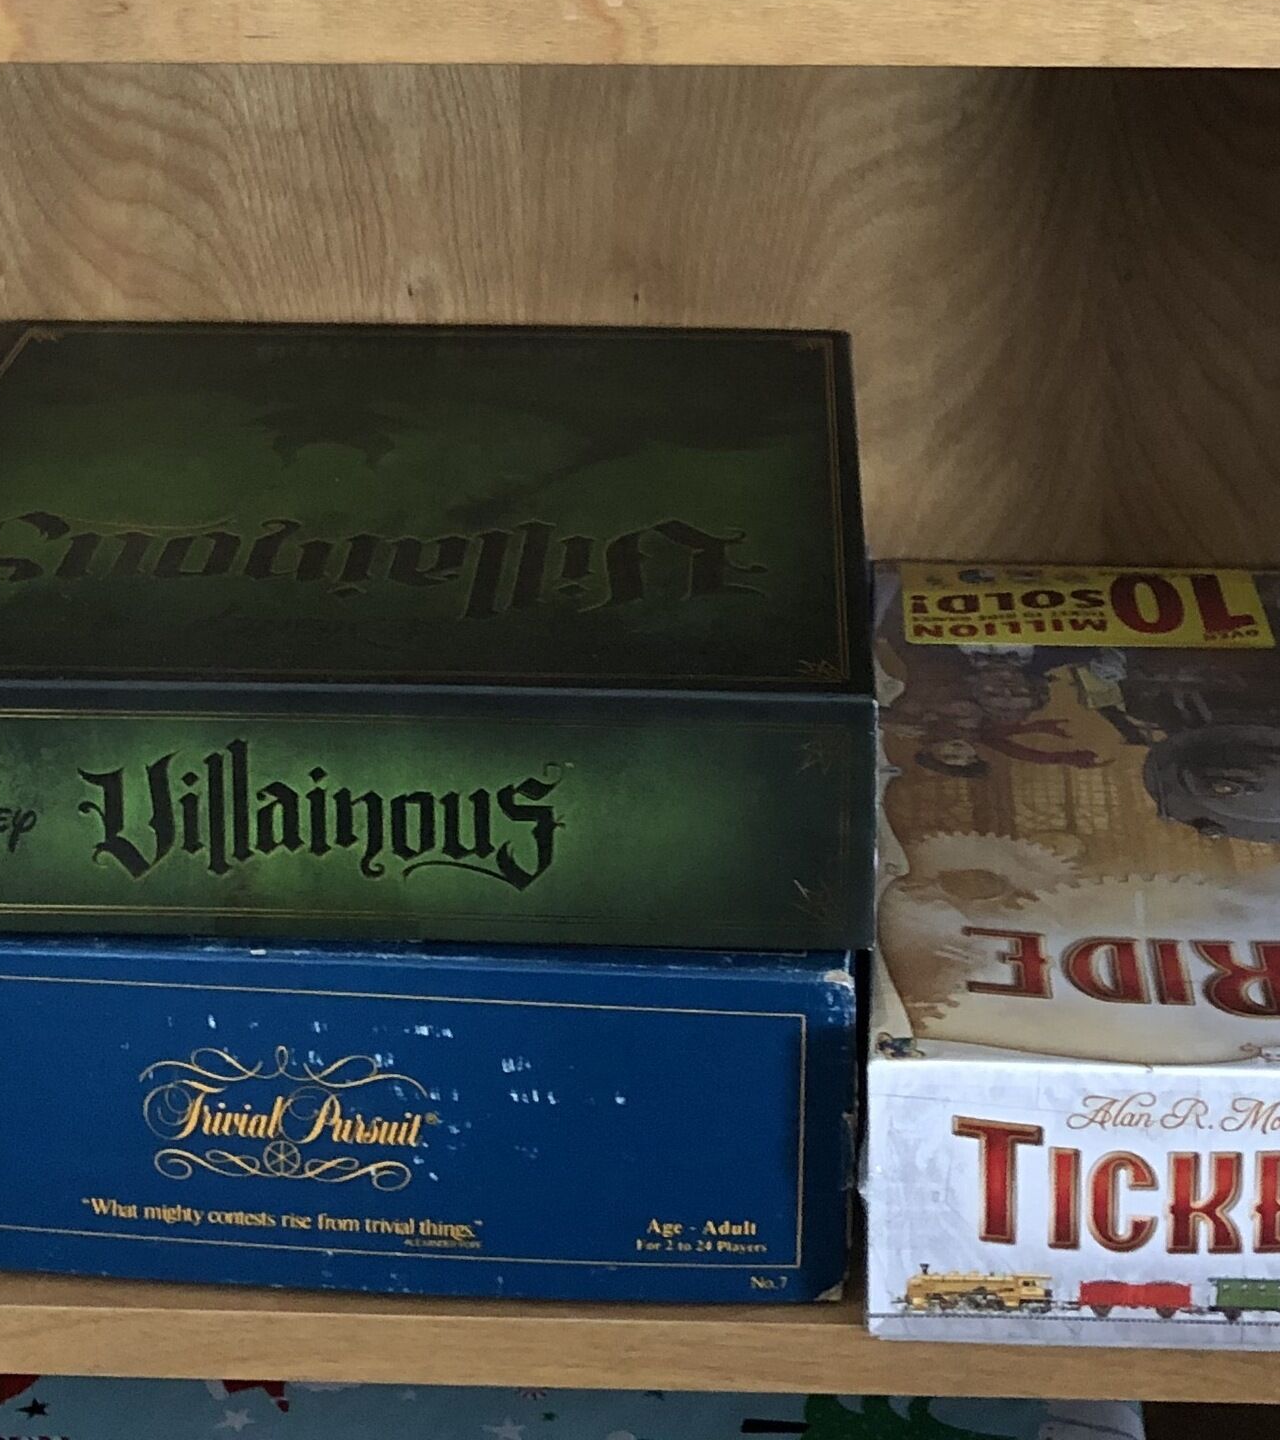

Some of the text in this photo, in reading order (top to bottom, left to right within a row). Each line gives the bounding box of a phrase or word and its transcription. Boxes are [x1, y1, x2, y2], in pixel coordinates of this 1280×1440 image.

[910, 587, 1109, 614] SOLD!
[1110, 573, 1255, 635] 10
[912, 617, 1108, 638] MILLION
[78, 738, 574, 892] Villainous
[143, 1079, 422, 1148] Trivial Pursuit
[1066, 1091, 1157, 1132] Alan
[1159, 1097, 1214, 1132] R.
[144, 1203, 203, 1226] mighty
[207, 1209, 277, 1229] contests
[281, 1213, 311, 1230] rise
[317, 1212, 359, 1233] from
[365, 1216, 415, 1236] trivial
[646, 1218, 683, 1238] Age
[702, 1219, 757, 1236] Adult
[636, 1239, 661, 1251] For
[677, 1240, 692, 1252] to
[716, 1240, 768, 1254] Players
